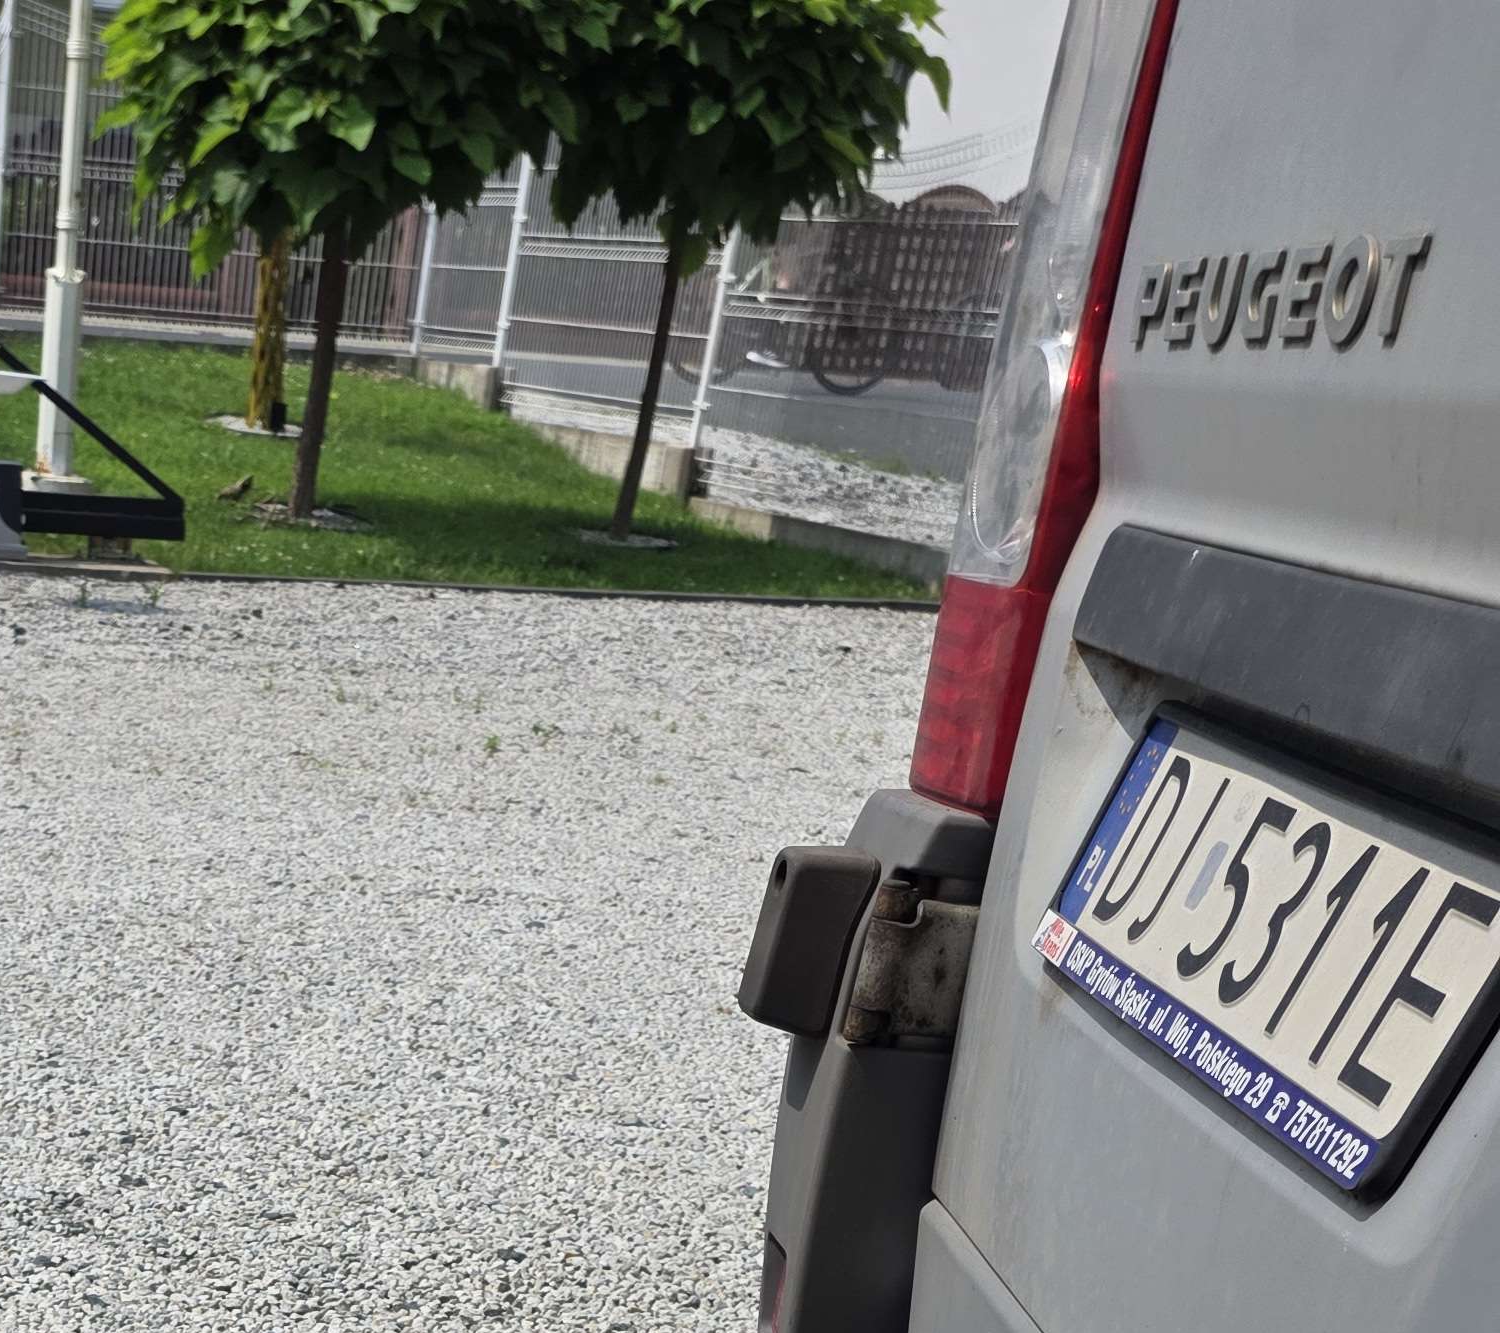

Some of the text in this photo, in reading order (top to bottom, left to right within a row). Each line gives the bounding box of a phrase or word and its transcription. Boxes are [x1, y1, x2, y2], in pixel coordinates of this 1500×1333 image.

[1130, 231, 1434, 354] PEUGEOT
[1076, 845, 1106, 892] PL
[1091, 755, 1500, 1108] DJ 5311E
[1066, 940, 1369, 1179] OSKP Gryfów Śląski, ul. Woj. Polskiego 29 757811292
